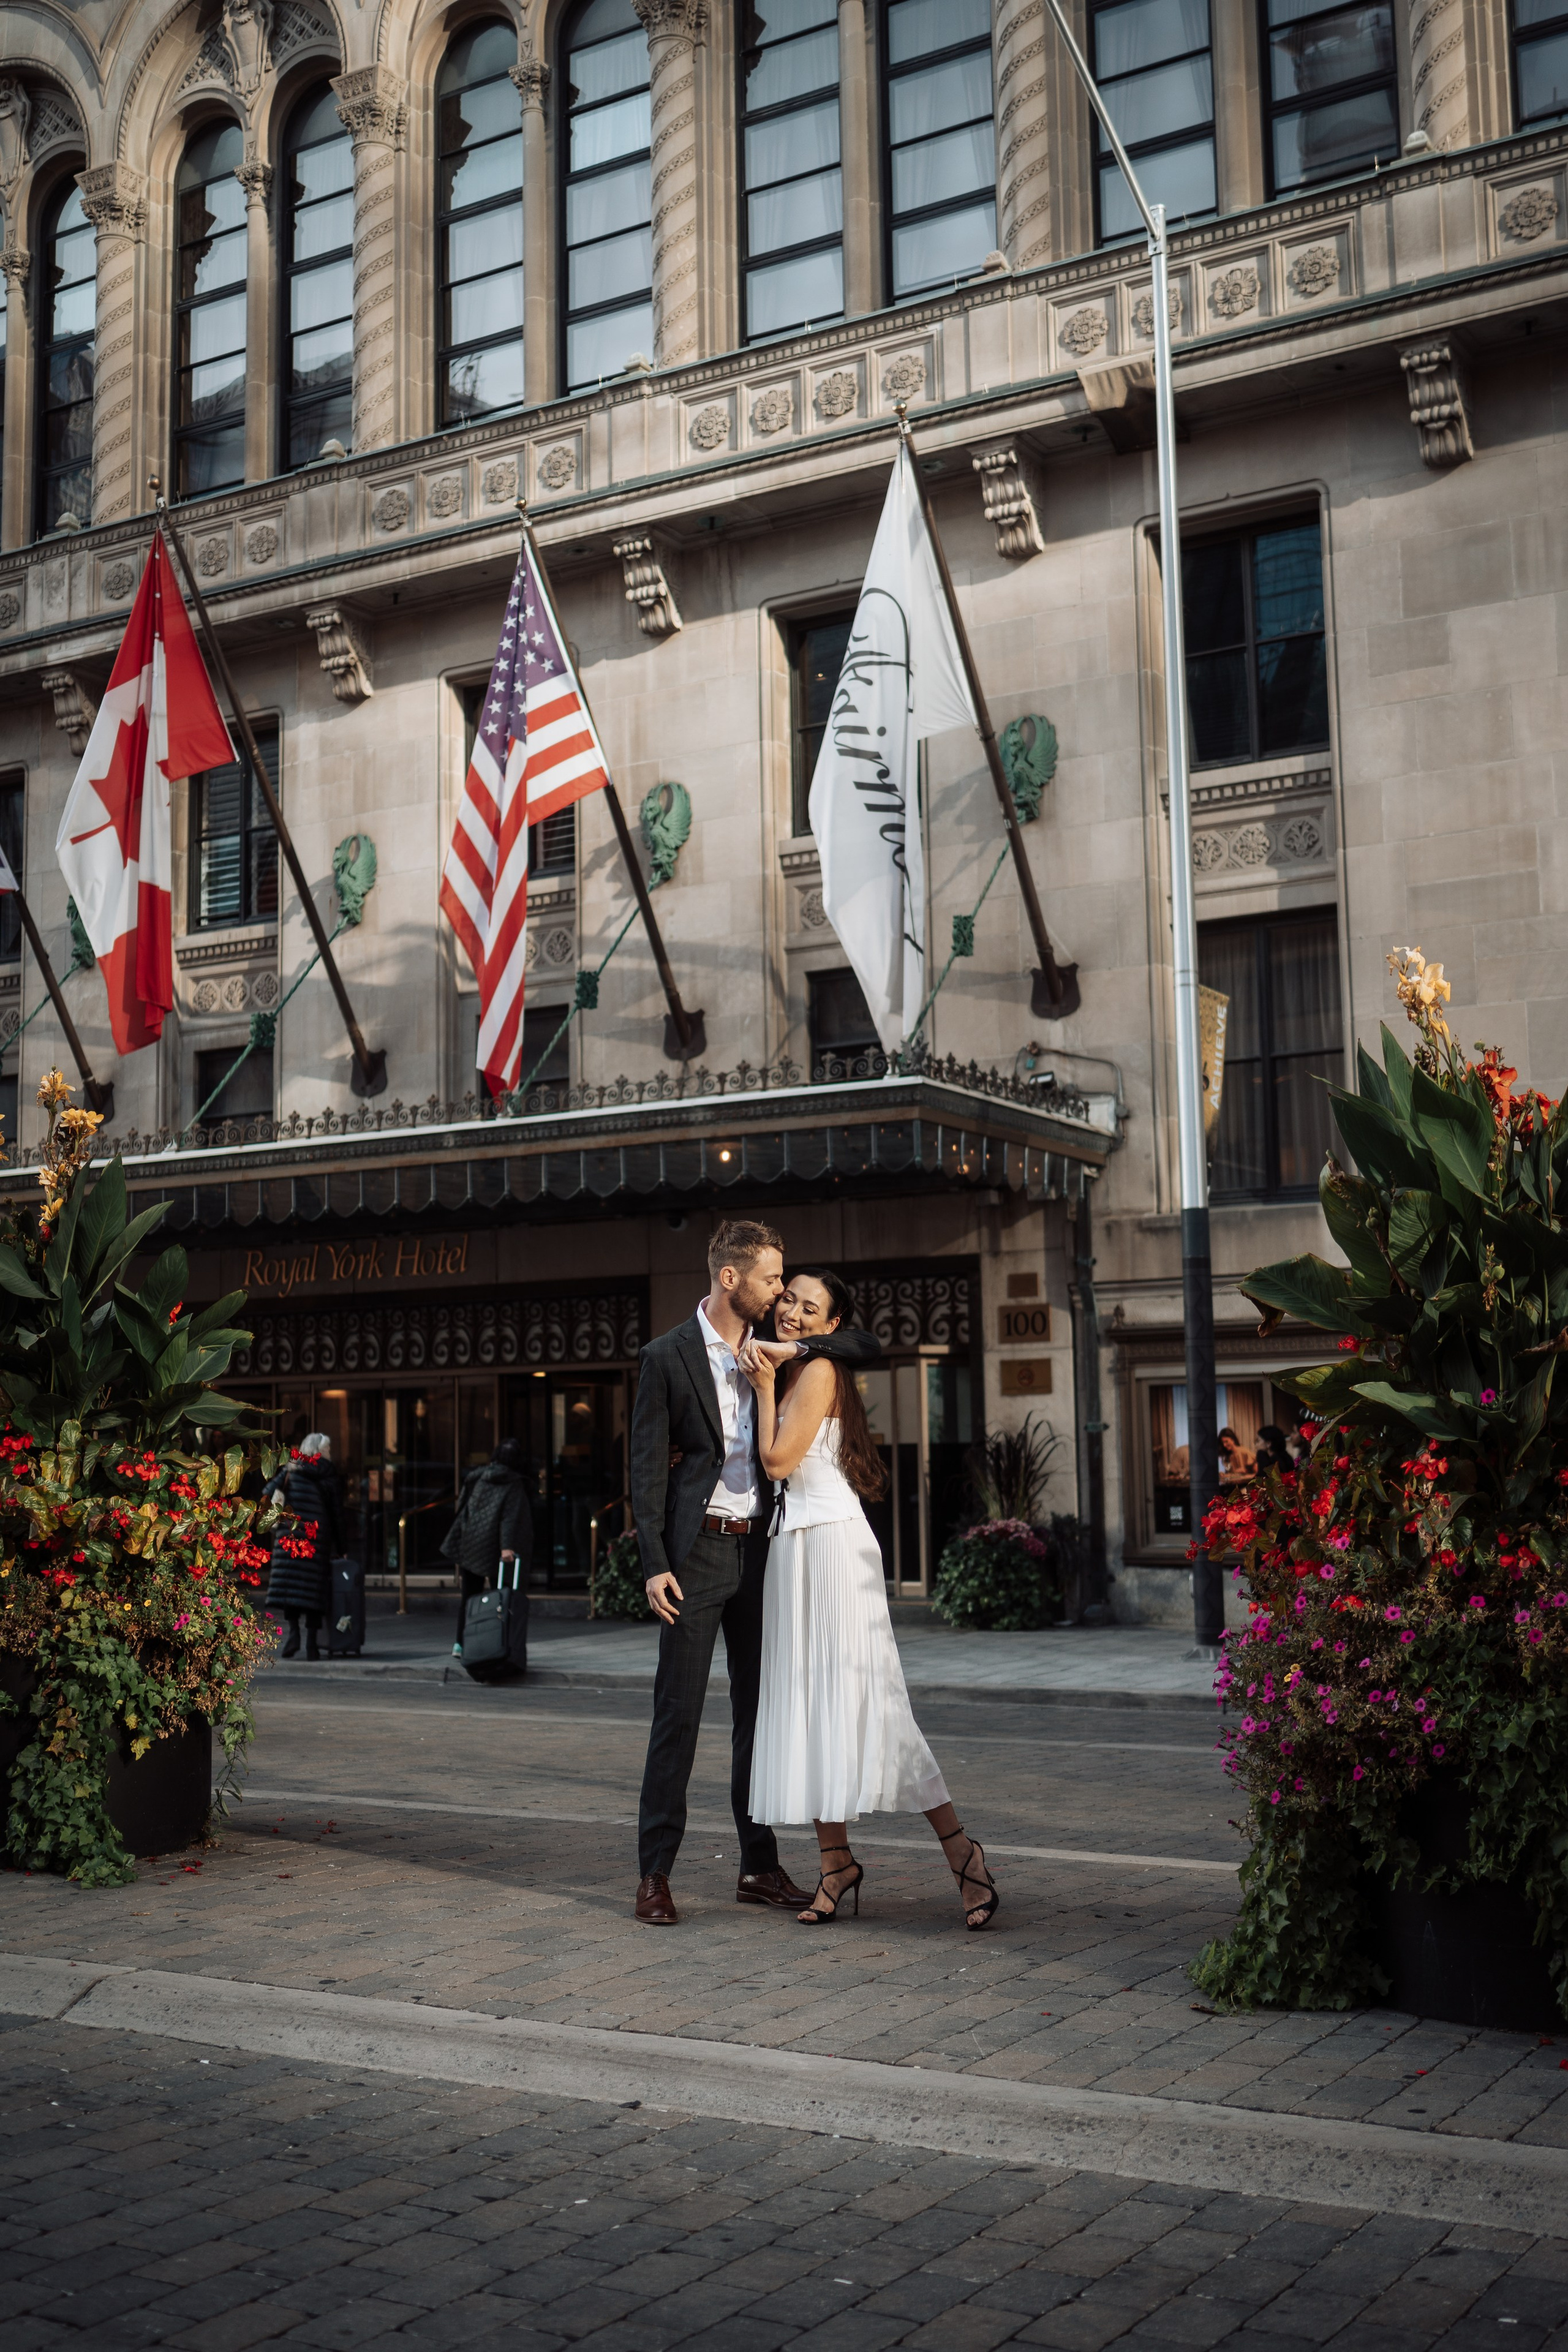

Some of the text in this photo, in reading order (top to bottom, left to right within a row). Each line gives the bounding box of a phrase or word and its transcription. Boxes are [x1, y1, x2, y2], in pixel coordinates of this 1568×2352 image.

[1210, 1004, 1227, 1110] ACHIEVE
[243, 1232, 469, 1298] Royal York Hotel
[1003, 1310, 1047, 1336] 100
